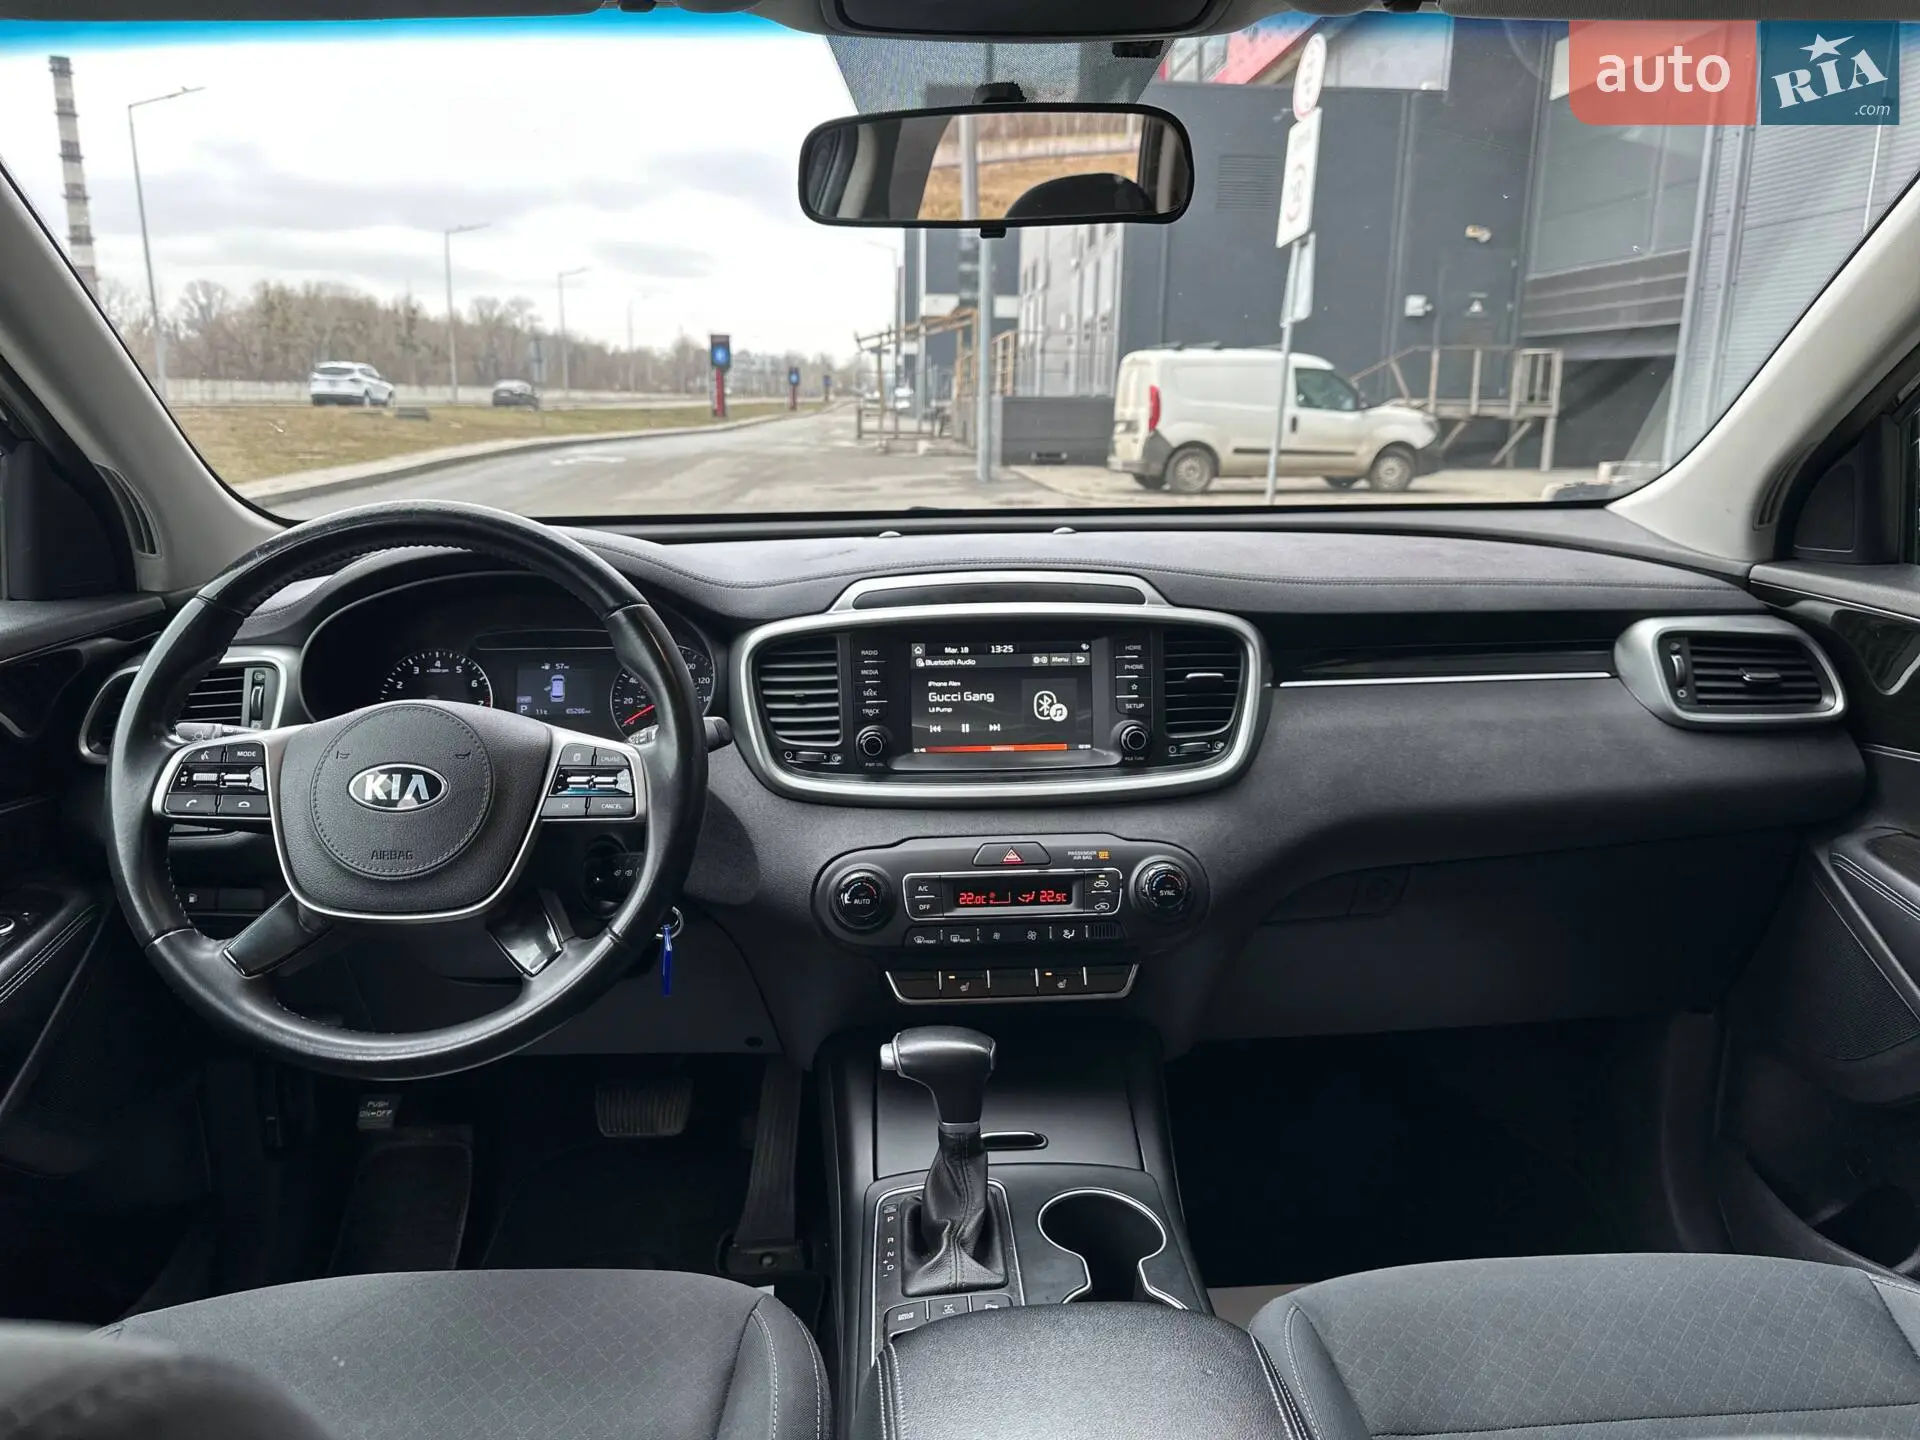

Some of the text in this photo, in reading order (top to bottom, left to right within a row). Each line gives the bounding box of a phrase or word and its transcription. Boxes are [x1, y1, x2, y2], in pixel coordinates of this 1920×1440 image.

[990, 645, 1014, 653] 13:25
[434, 660, 441, 668] 4
[925, 658, 956, 666] Bluetooth
[413, 666, 420, 674] 3
[455, 665, 462, 673] 5
[396, 681, 403, 689] 2
[471, 679, 478, 687] 6
[623, 697, 634, 705] 20
[928, 691, 995, 703] Gucci Gang
[520, 705, 528, 713] P
[364, 773, 430, 801] KIA
[370, 850, 414, 860] AIRBAG
[1159, 889, 1175, 897] SYNC
